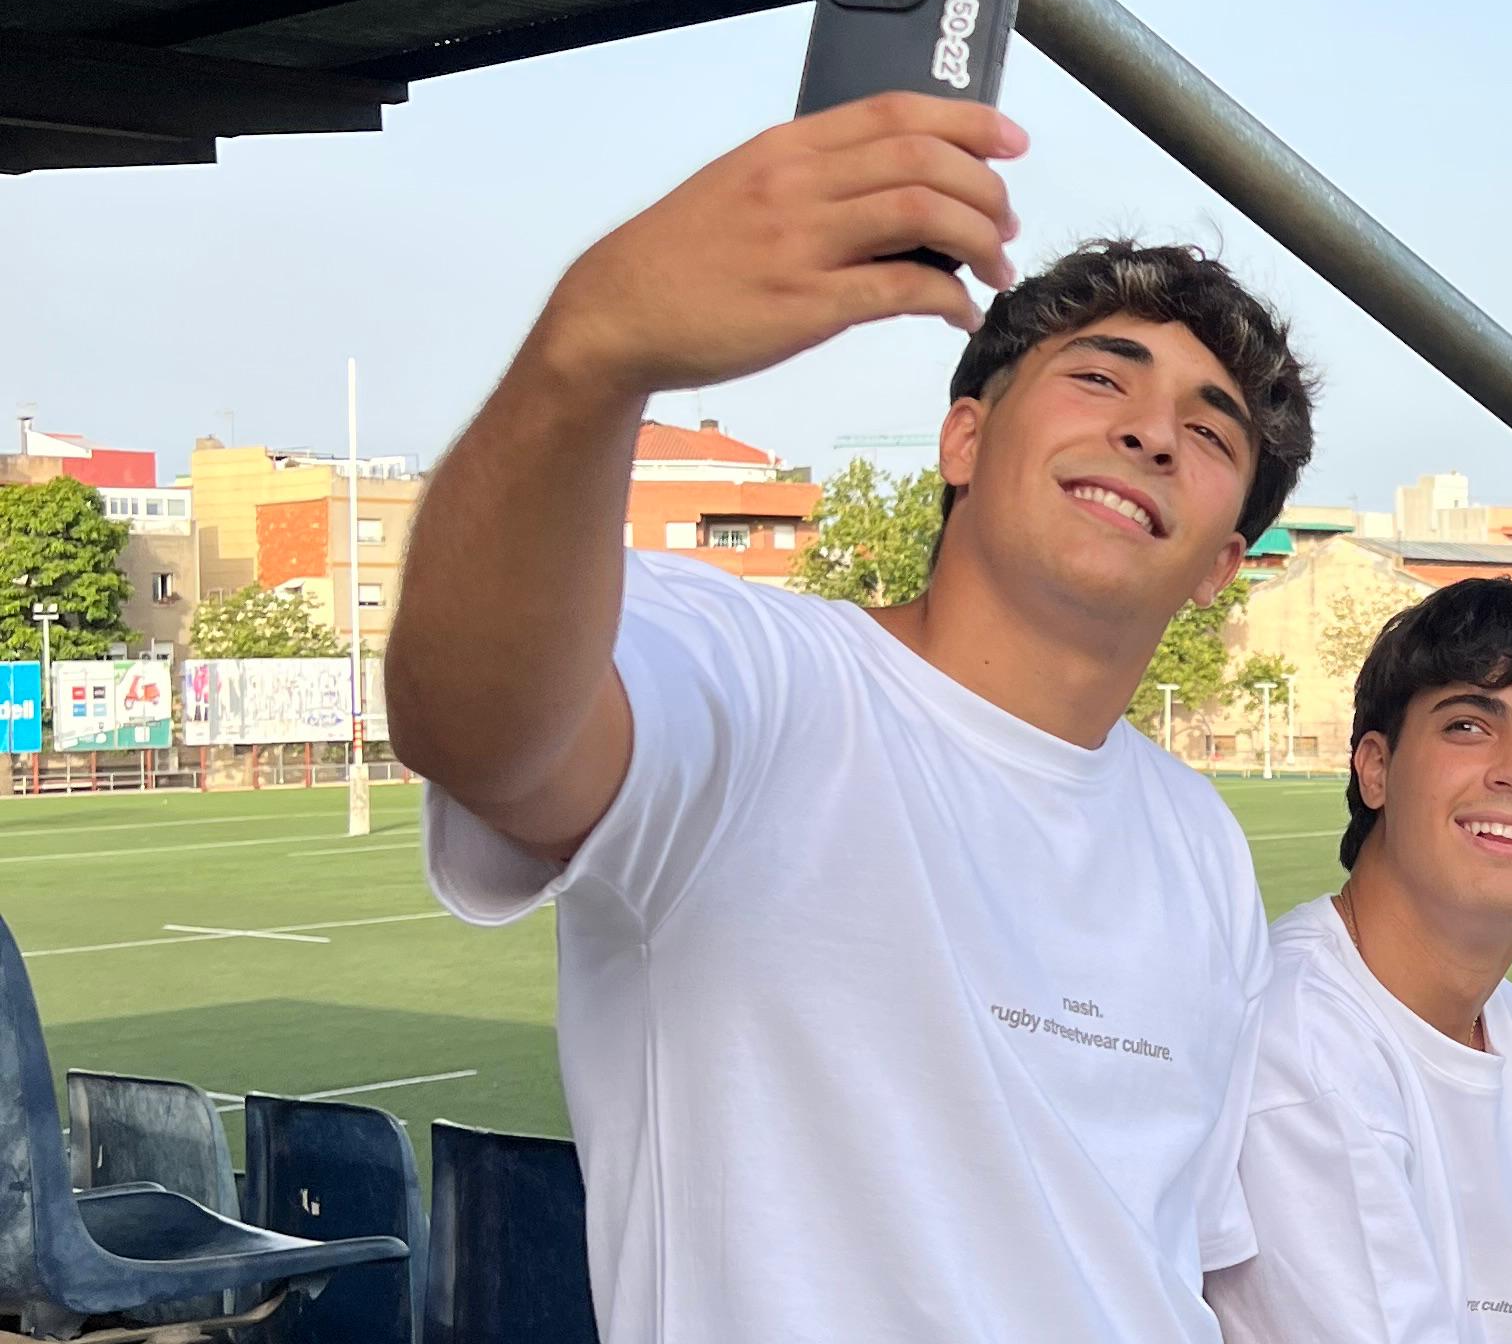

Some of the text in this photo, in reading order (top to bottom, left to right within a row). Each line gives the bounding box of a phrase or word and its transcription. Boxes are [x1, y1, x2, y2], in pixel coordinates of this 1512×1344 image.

[1062, 997, 1104, 1018] nash.
[990, 1004, 1173, 1062] rugby streetwear culture.
